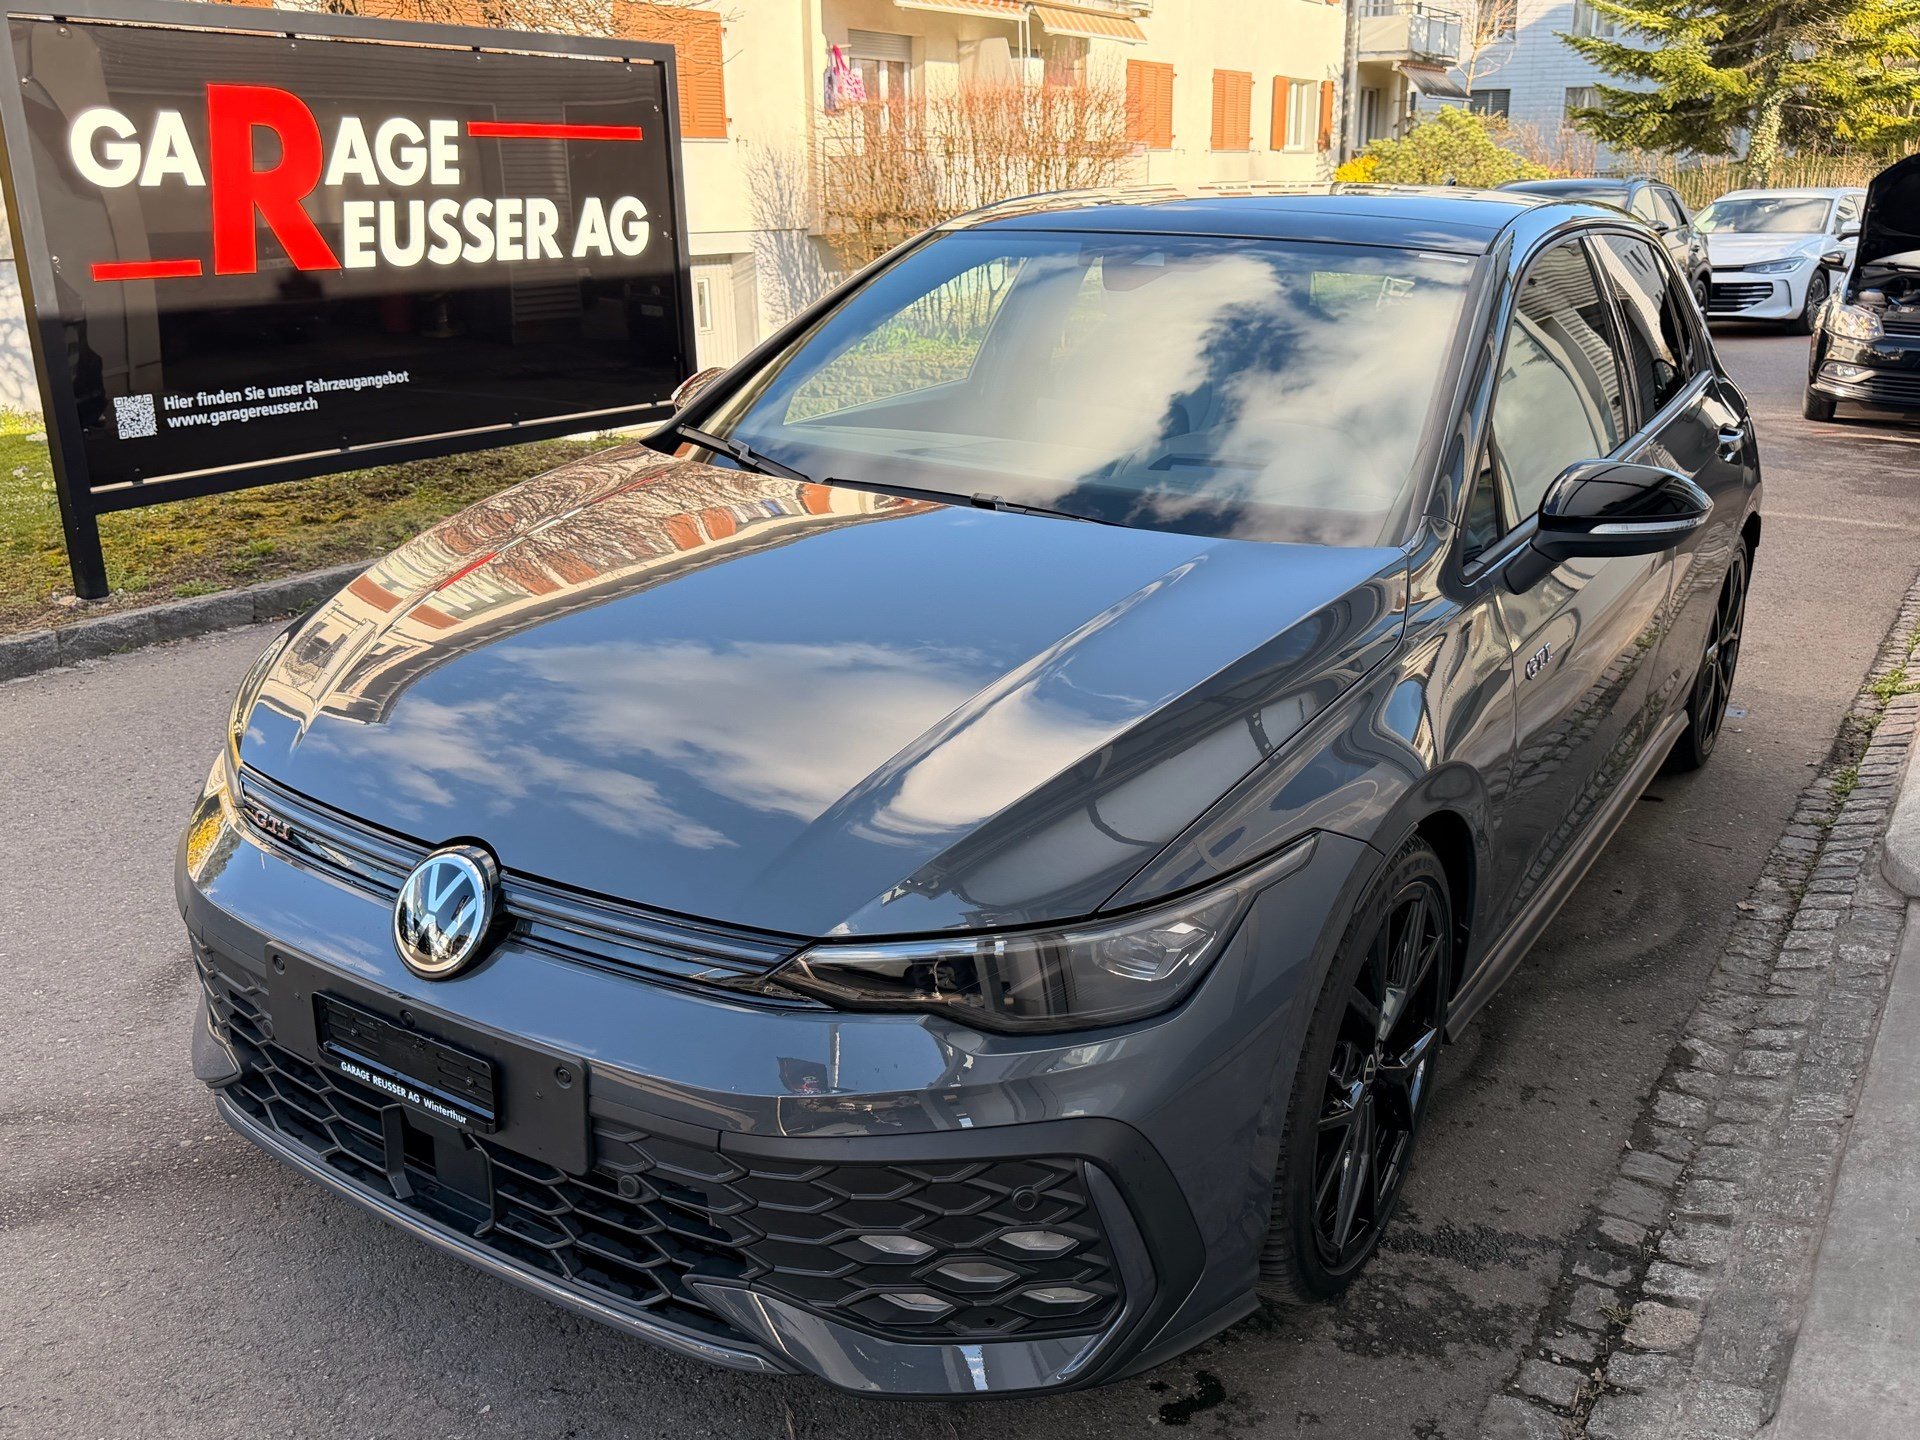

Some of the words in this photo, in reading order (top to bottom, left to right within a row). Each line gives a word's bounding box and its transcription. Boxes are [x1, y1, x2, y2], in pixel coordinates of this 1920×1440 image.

[70, 84, 460, 275] GARAGE
[572, 196, 650, 256] AG
[163, 395, 194, 411] Hier
[196, 390, 242, 407] finden
[245, 386, 265, 401] Sie
[267, 383, 303, 397] unser
[305, 370, 410, 394] Fahrzeugangebot
[167, 397, 319, 428] www.garagereusser.ch
[1525, 641, 1553, 680] GTI
[255, 810, 290, 840] GTI
[341, 1061, 371, 1082] GARAGE
[372, 1075, 406, 1098] REUSSER
[408, 1091, 420, 1103] AG
[423, 1097, 467, 1124] Winterthur
